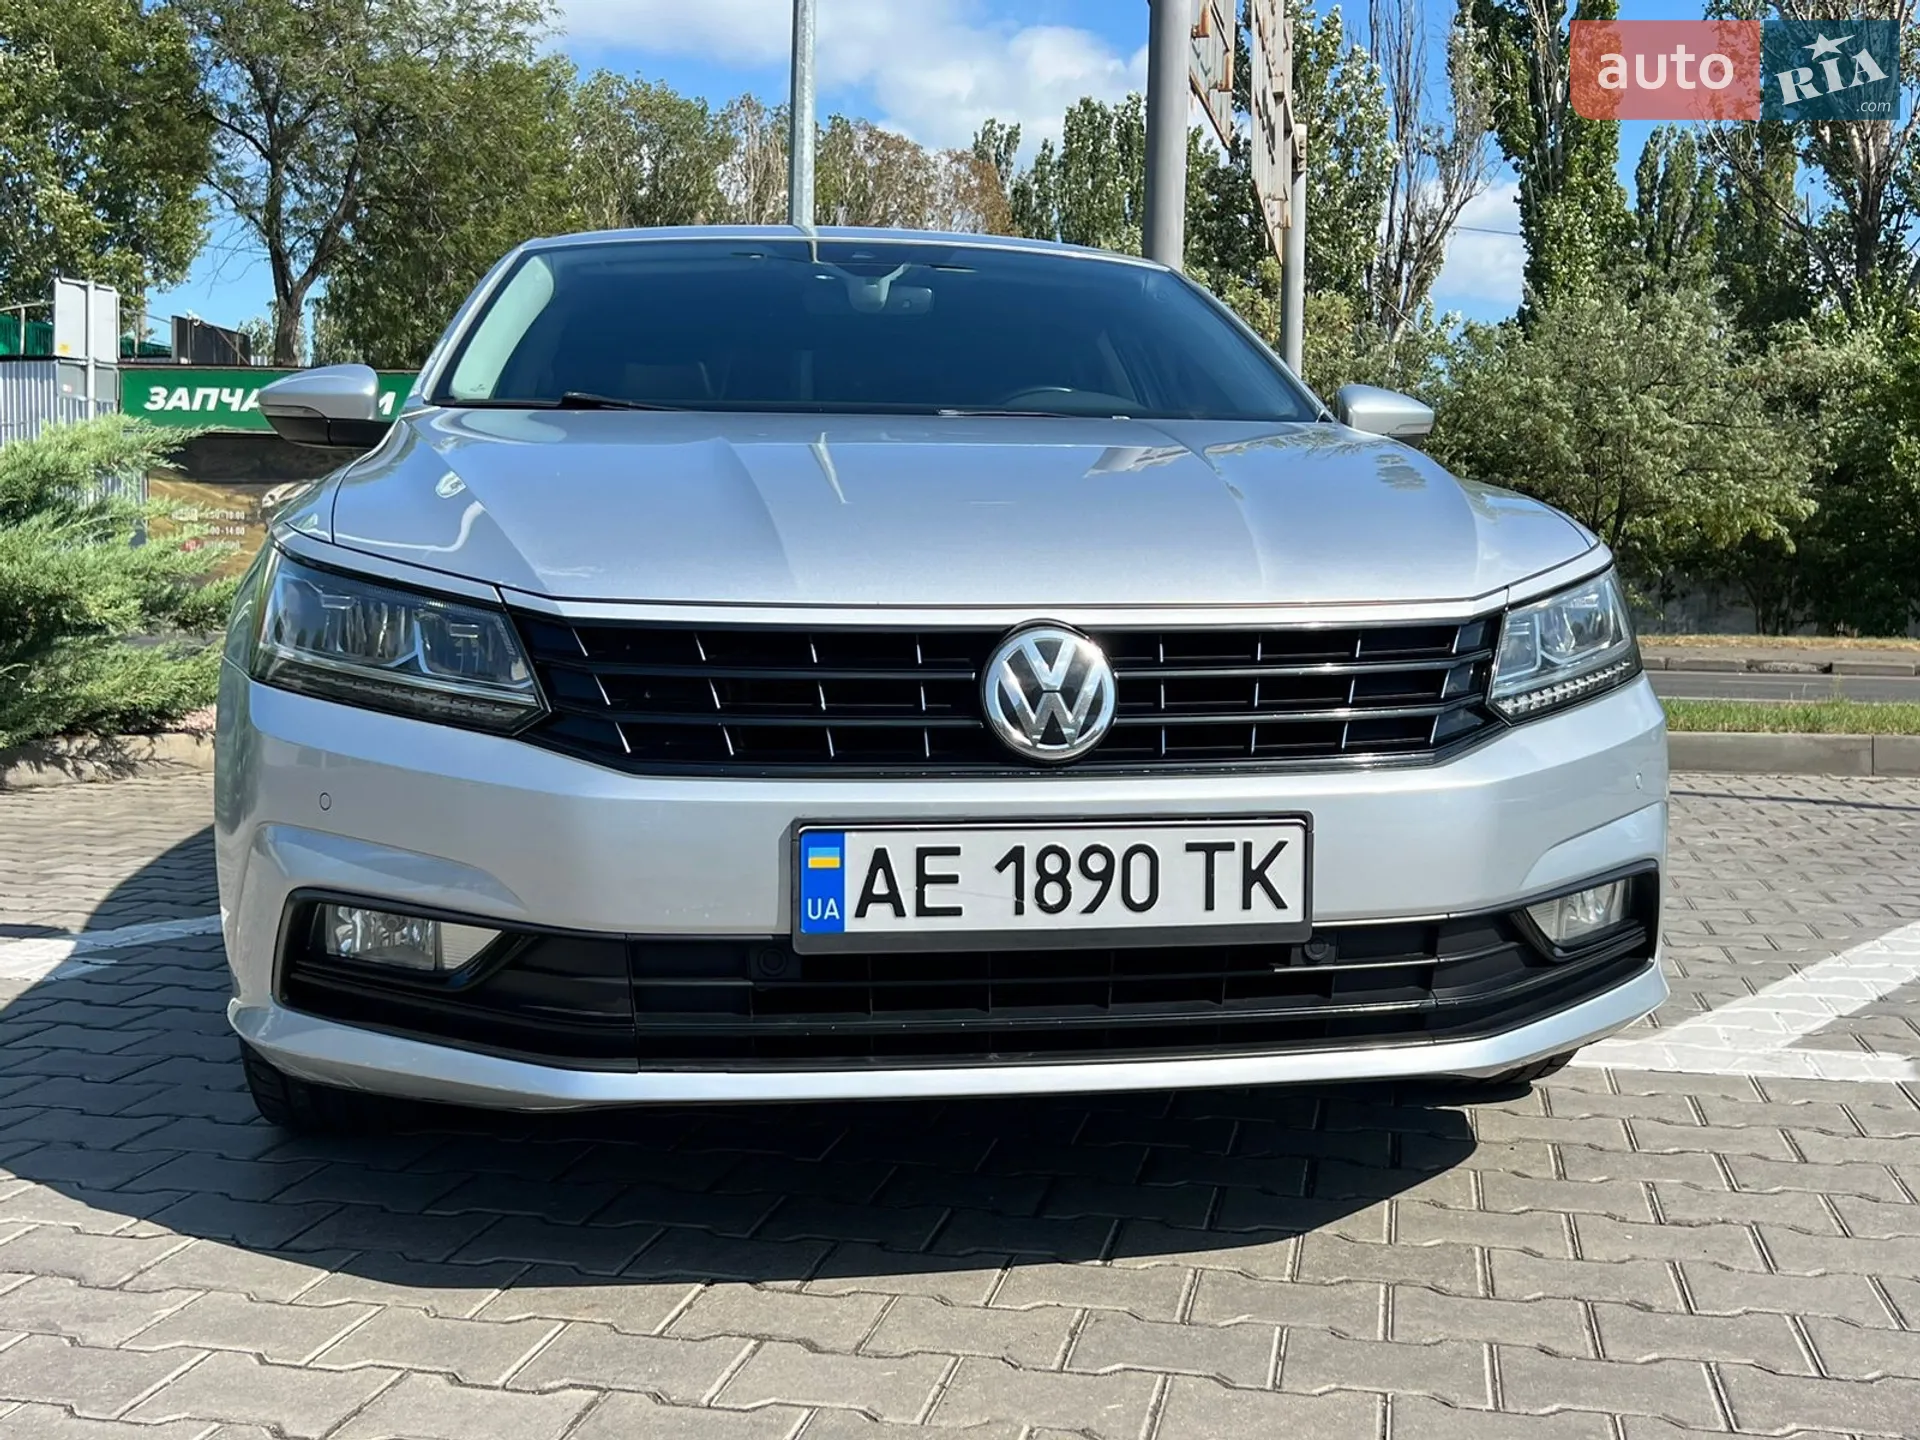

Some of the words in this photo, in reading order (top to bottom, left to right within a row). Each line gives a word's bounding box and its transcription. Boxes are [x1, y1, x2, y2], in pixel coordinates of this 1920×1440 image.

[143, 386, 260, 412] ЗАПЧА
[855, 846, 963, 919] AE
[995, 843, 1159, 916] 1890
[1186, 840, 1289, 912] TK
[807, 898, 840, 920] UA
